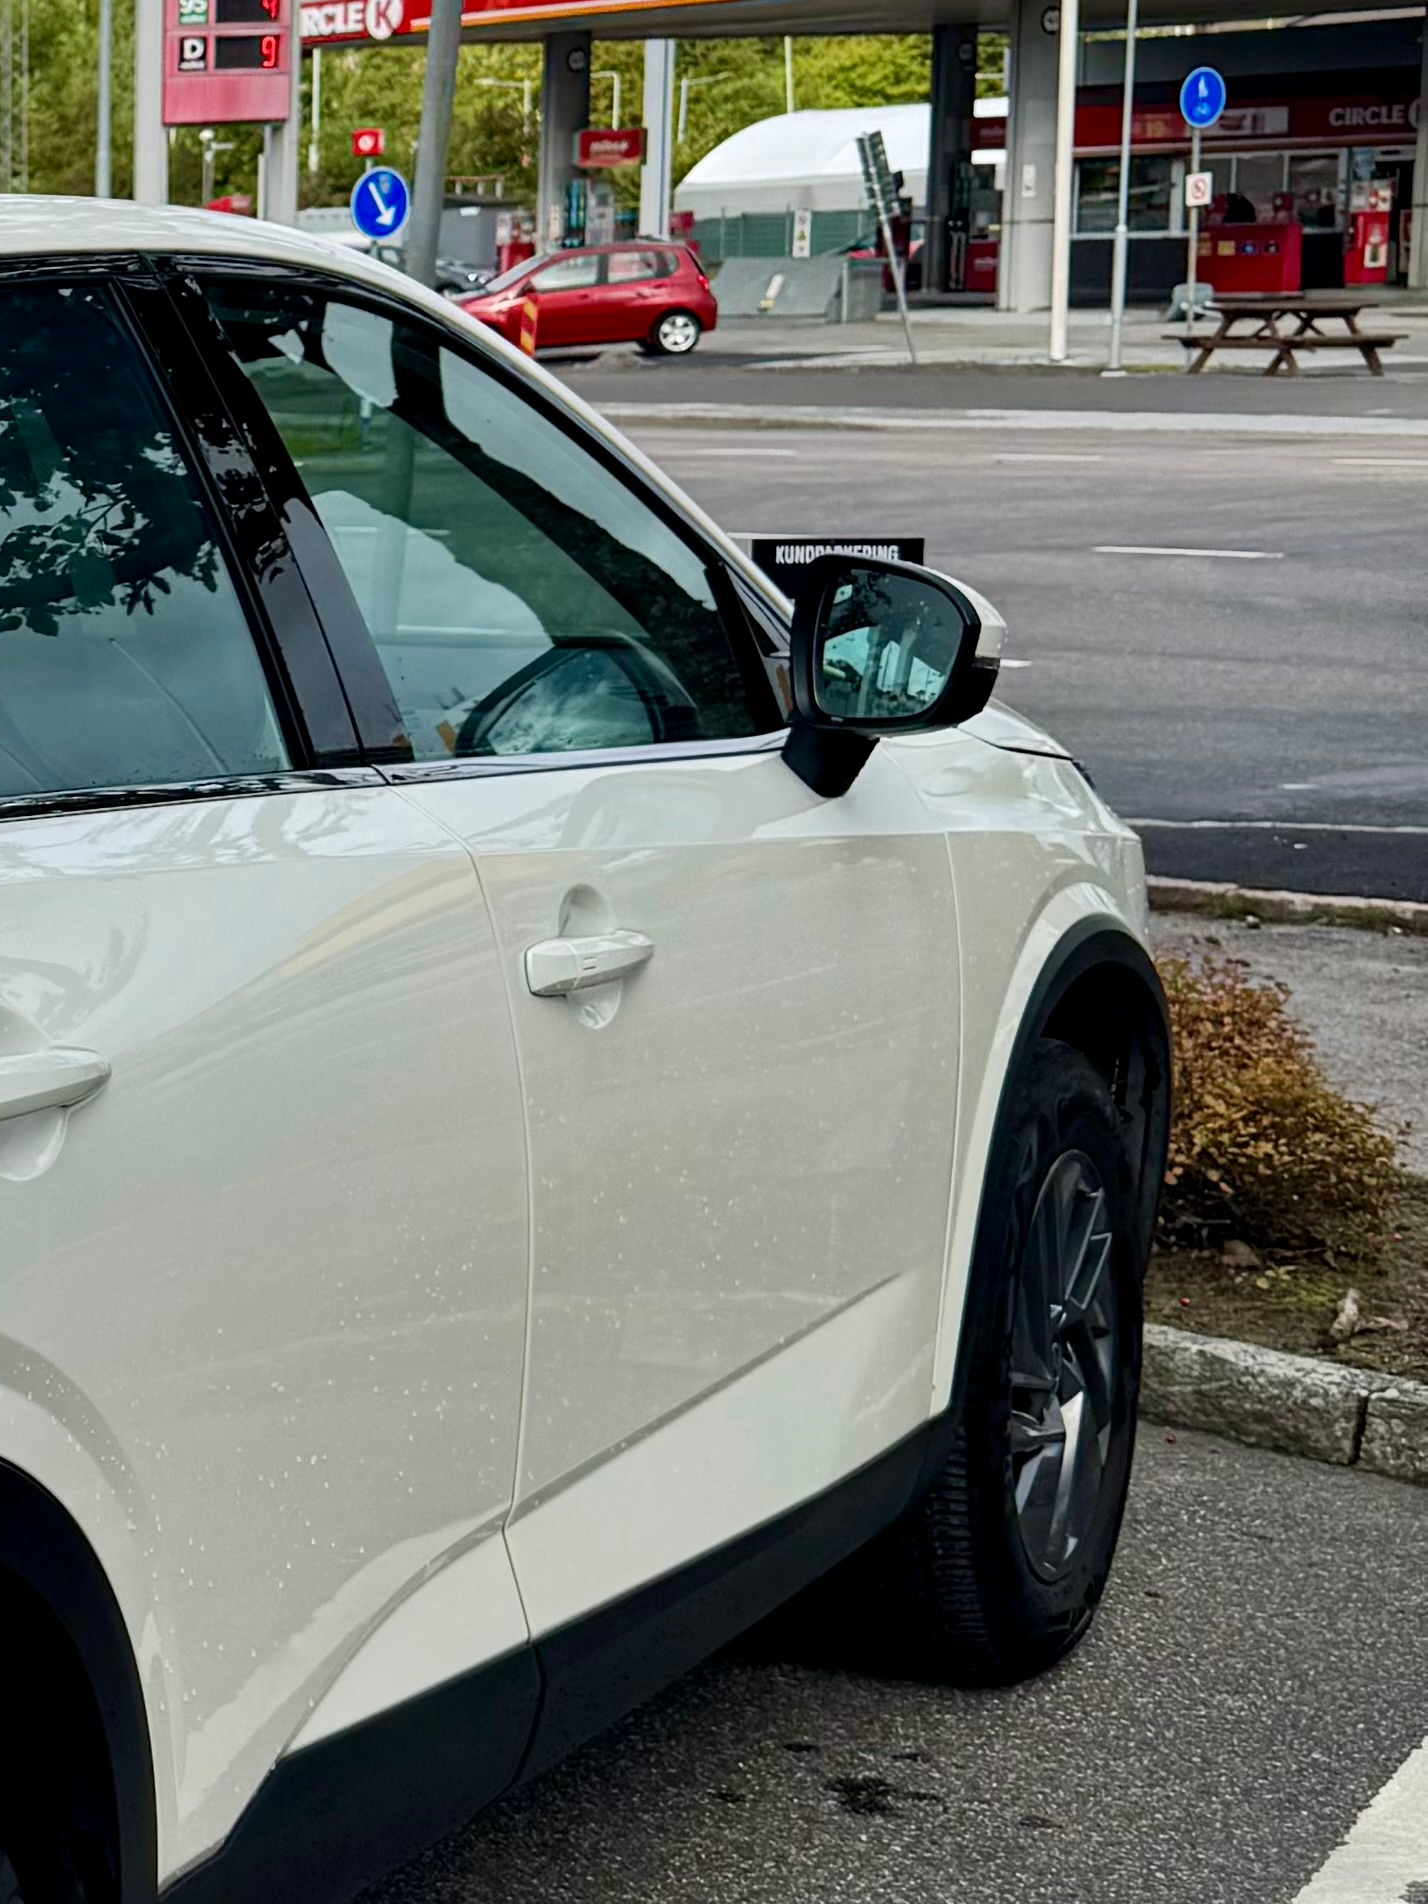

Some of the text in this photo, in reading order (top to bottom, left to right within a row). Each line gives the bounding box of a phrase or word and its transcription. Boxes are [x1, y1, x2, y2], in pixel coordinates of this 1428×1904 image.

[301, 2, 364, 36] RCLE
[183, 38, 205, 60] D
[1329, 104, 1405, 128] CIRCLE
